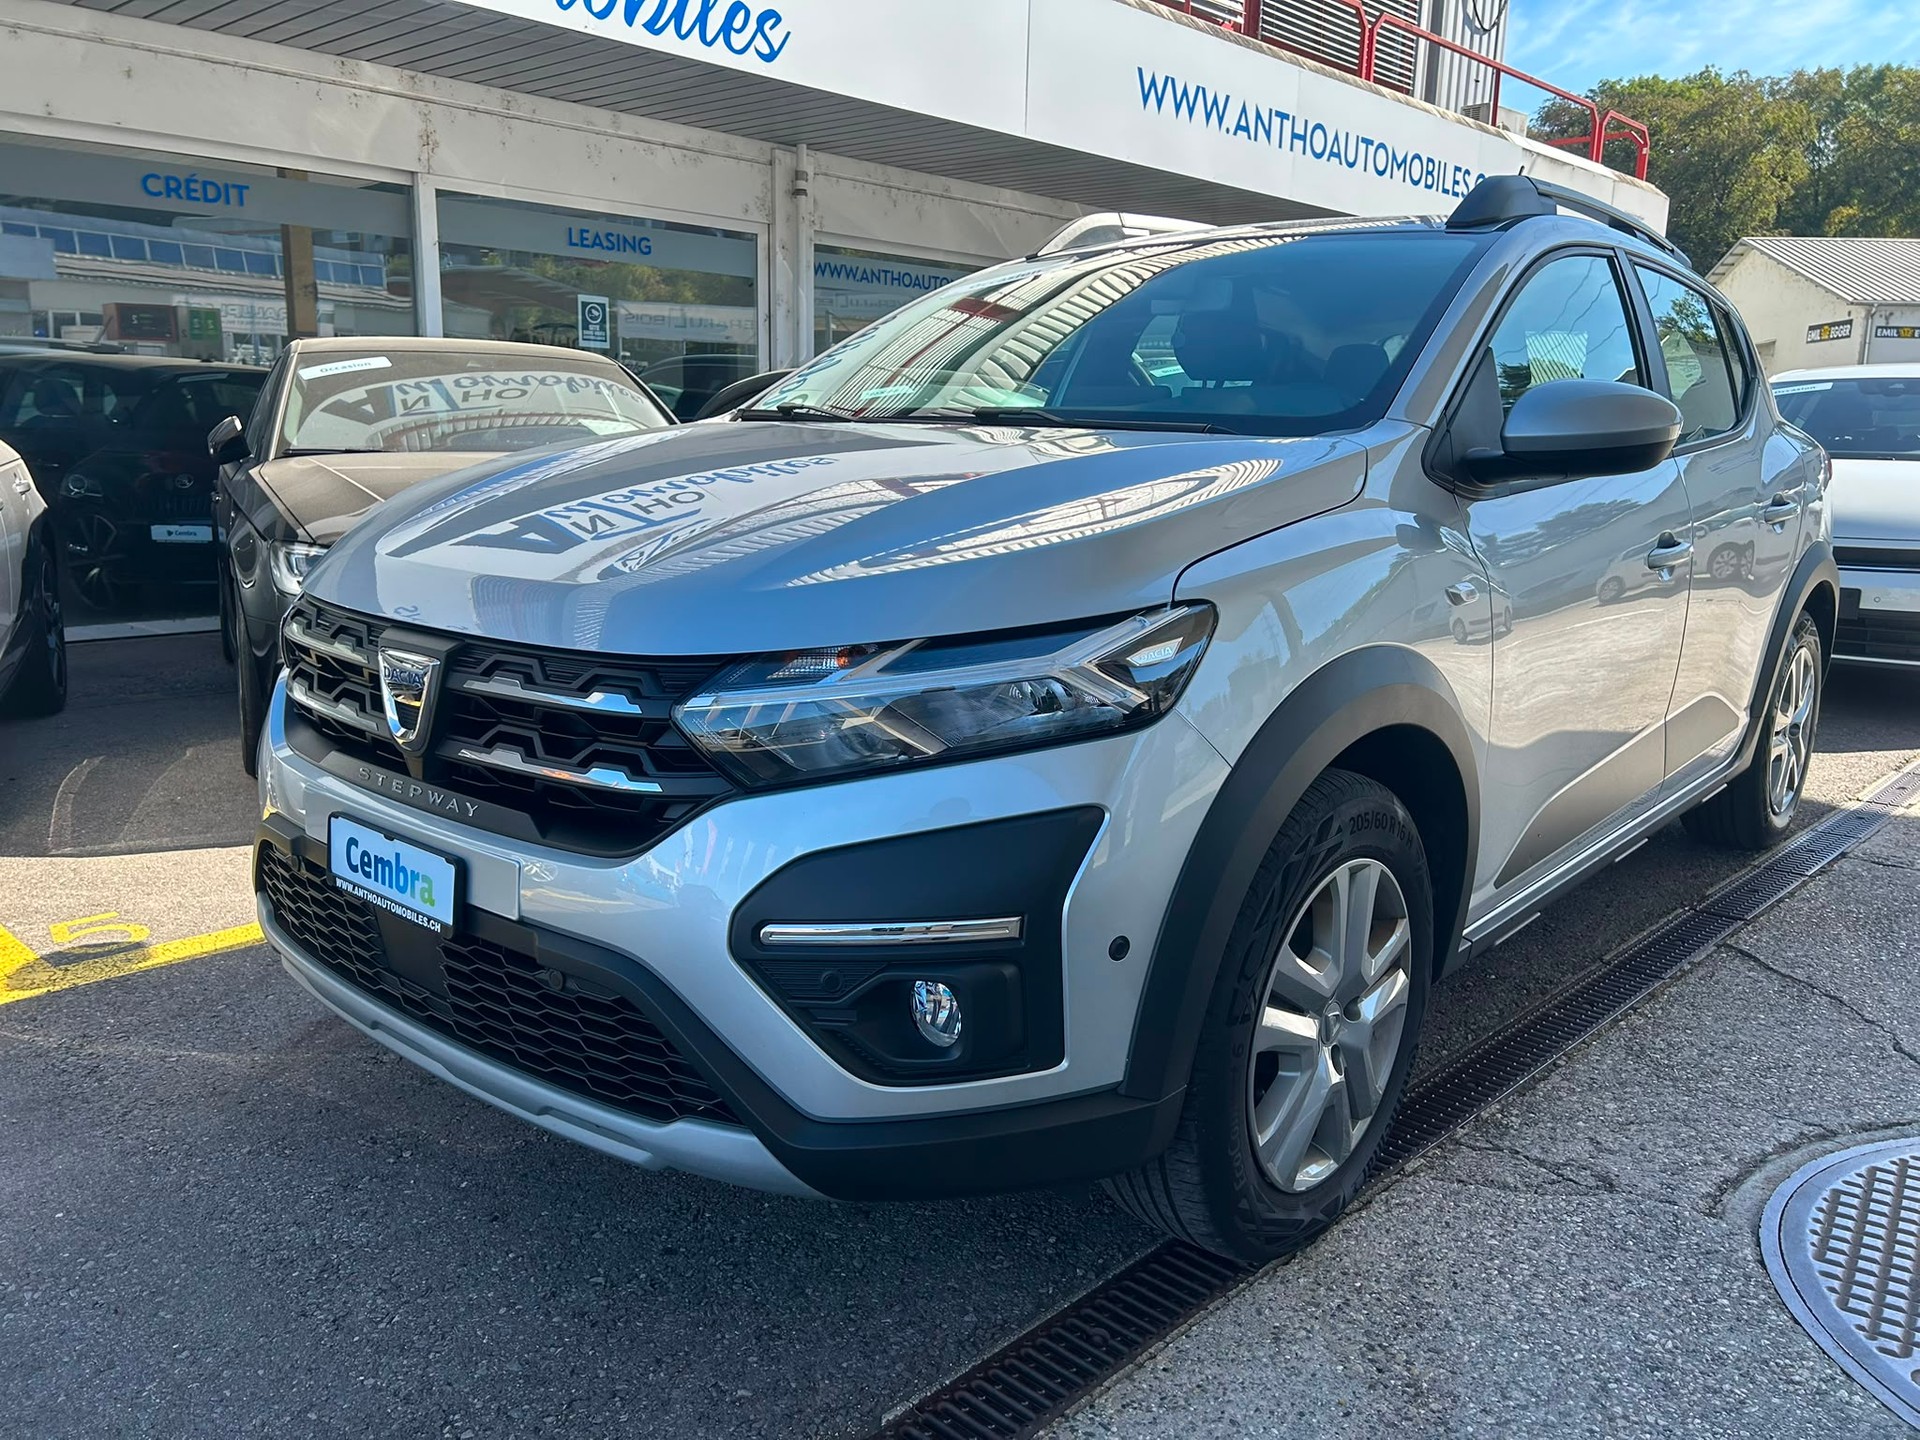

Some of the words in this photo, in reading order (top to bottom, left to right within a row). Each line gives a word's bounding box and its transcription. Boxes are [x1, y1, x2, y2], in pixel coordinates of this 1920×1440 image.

[141, 172, 250, 207] CRÉDIT
[568, 227, 653, 256] LEASING
[813, 262, 954, 291] WWW.ANTHOAUTO
[1876, 327, 1898, 337] EMIL
[320, 361, 372, 373] Occasion
[383, 664, 423, 686] DACIA
[358, 767, 479, 817] STEPWAY
[346, 836, 435, 907] Cembra
[335, 877, 441, 933] WWW.ANTHOAUTOMOBILES.CH
